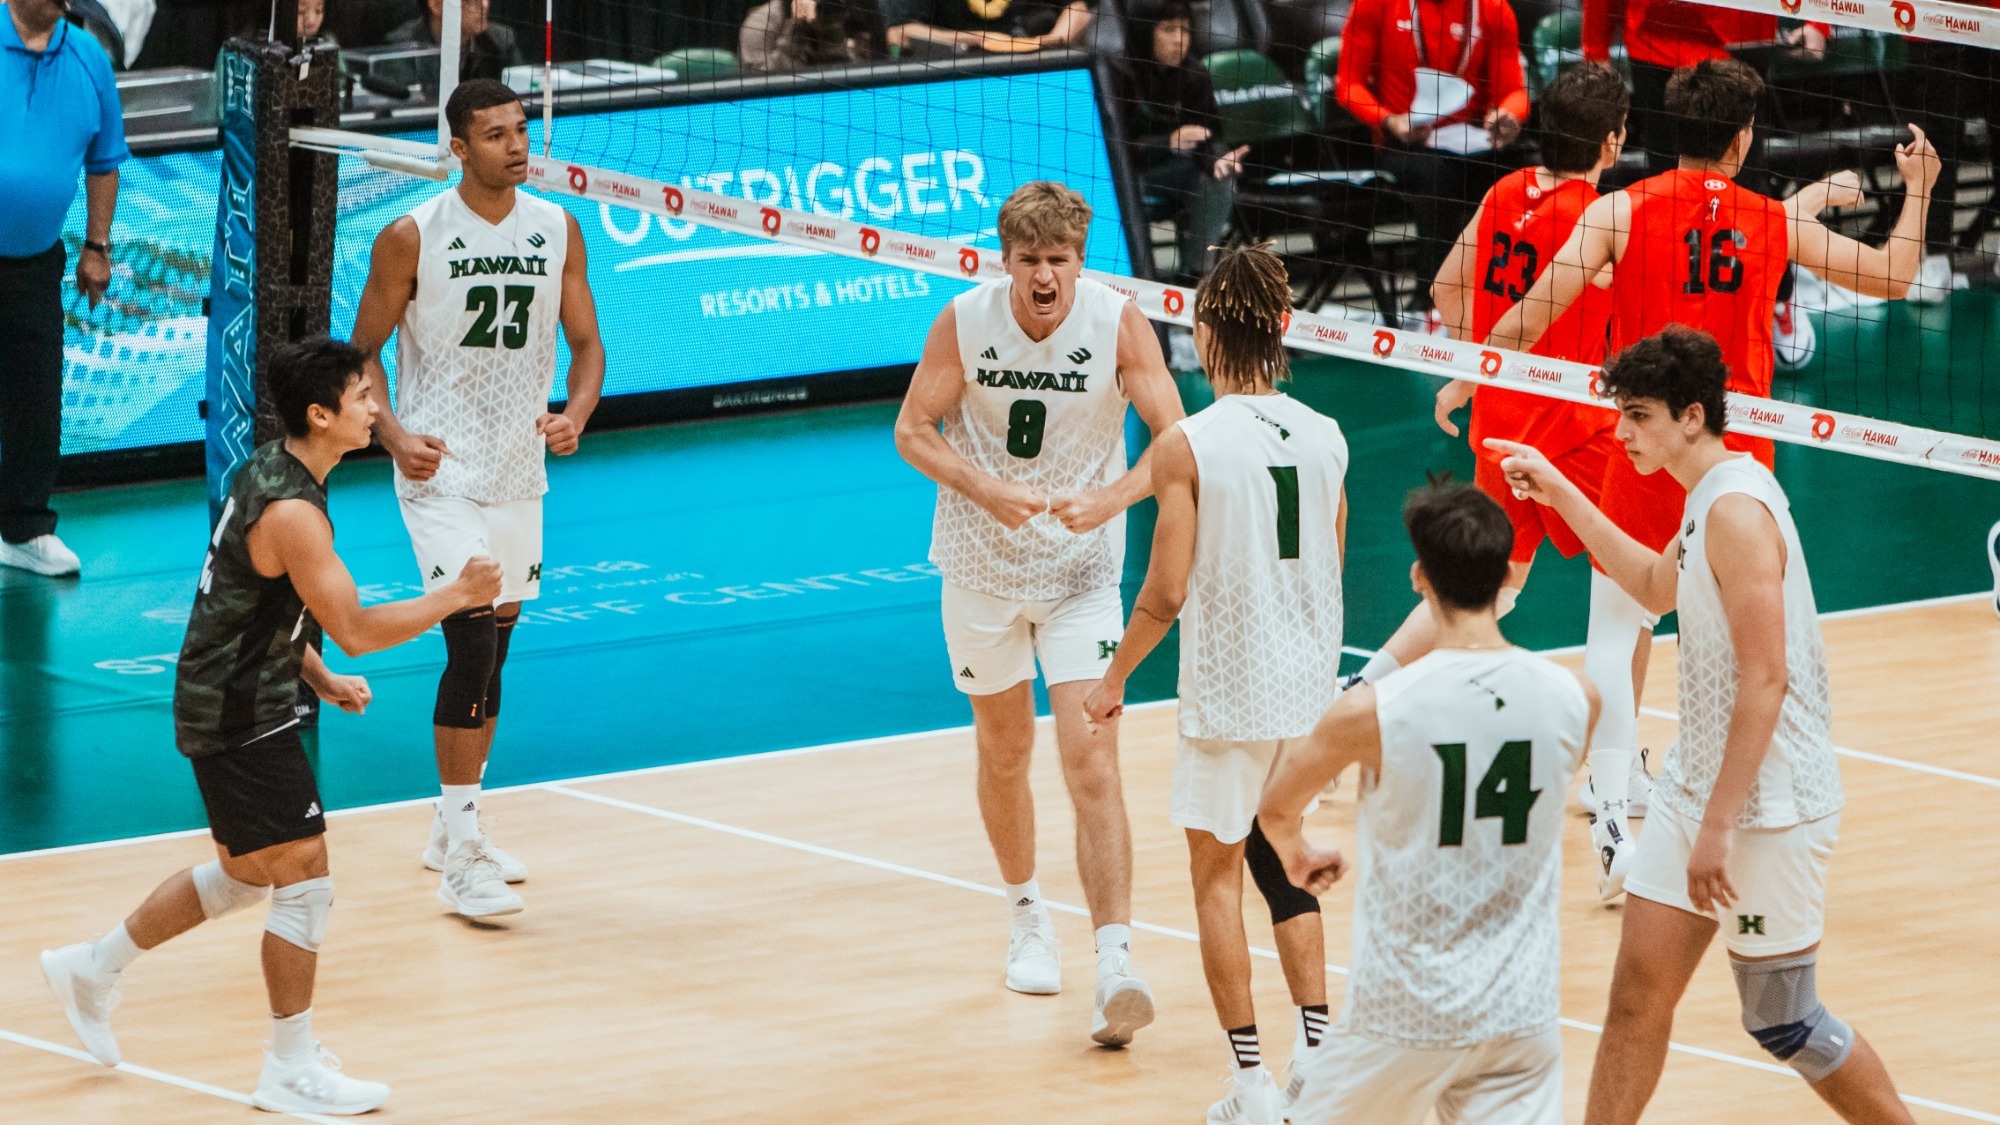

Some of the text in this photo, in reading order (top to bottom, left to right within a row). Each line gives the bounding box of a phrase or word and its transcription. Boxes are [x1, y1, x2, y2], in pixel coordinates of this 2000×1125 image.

[1831, 0, 1865, 15] HAWAII
[1945, 16, 1980, 33] HAWAII
[612, 181, 641, 198] HAWAII
[708, 203, 738, 219] HAWAII
[806, 223, 836, 240] HAWAII
[905, 243, 936, 260] HAWAII
[1483, 231, 1538, 304] 23
[1683, 229, 1747, 294] 16
[701, 272, 931, 318] RESORTS & HOTELS
[459, 285, 535, 349] 23
[1315, 325, 1348, 342] HAWAII
[1420, 345, 1454, 362] HAWAII
[1528, 366, 1562, 383] HAWAII
[1749, 407, 1785, 425] HAWAII
[1006, 399, 1047, 459] 8
[1863, 429, 1898, 446] HAWAII
[1978, 450, 2000, 466] HAW
[1267, 466, 1300, 560] 1
[1430, 740, 1544, 848] 14
